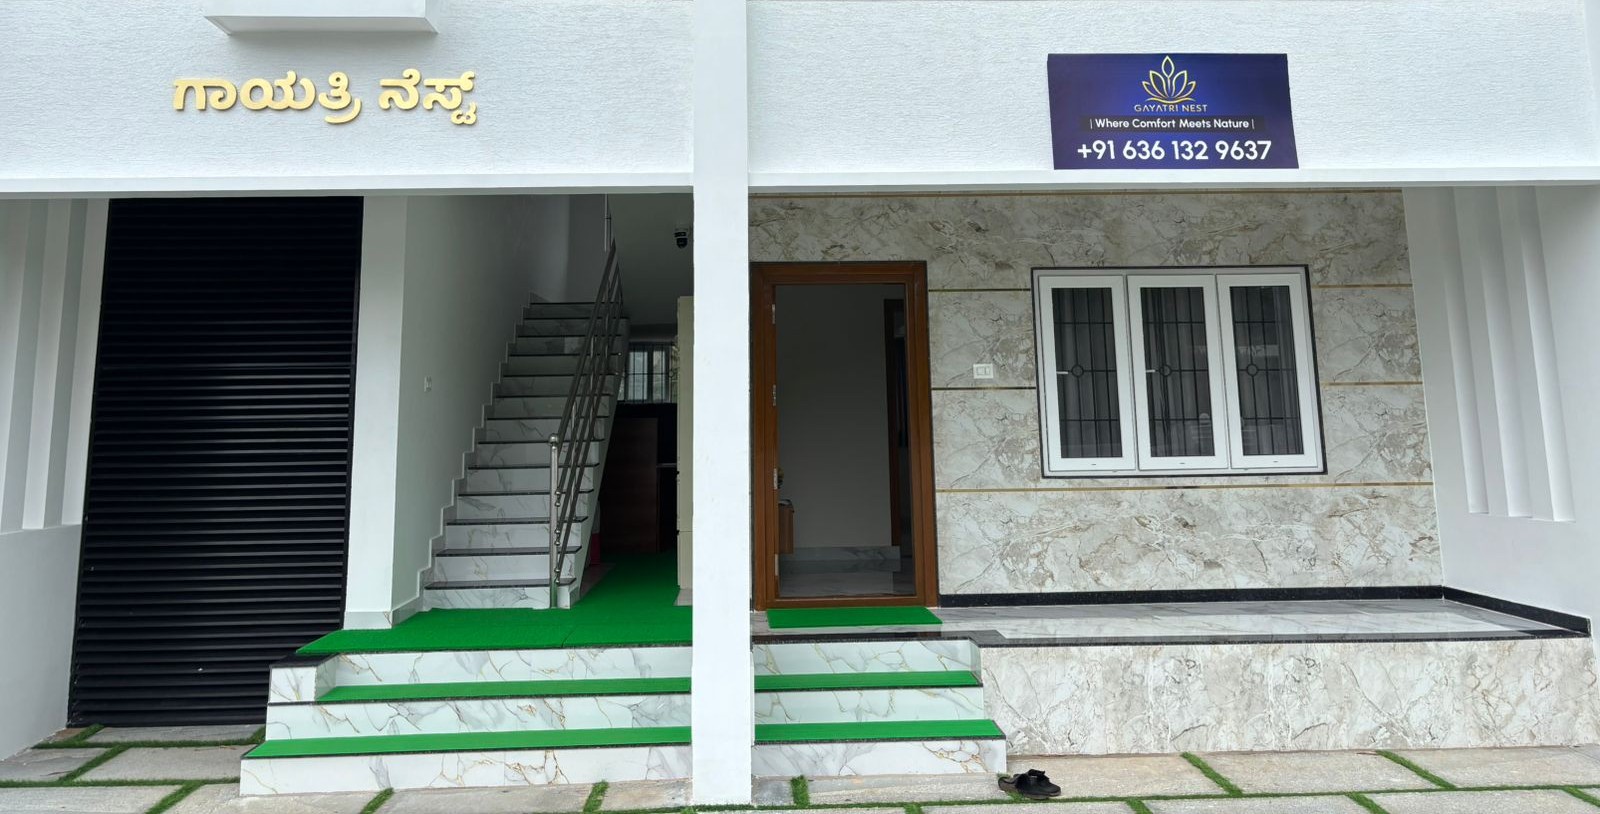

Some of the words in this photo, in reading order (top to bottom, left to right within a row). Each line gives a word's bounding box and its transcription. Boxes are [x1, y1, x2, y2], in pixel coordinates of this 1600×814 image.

[173, 70, 362, 124] ಗಾಯತ್ರಿ
[1134, 104, 1179, 112] GAYATRI
[1182, 104, 1208, 112] NEST
[1095, 118, 1130, 128] Where
[1132, 118, 1176, 128] Comfort
[1179, 118, 1211, 128] Meets
[1213, 118, 1249, 128] Nature
[1077, 140, 1116, 160] +91
[1122, 140, 1166, 160] 636
[1171, 140, 1209, 160] 132
[1215, 140, 1272, 160] 9637
